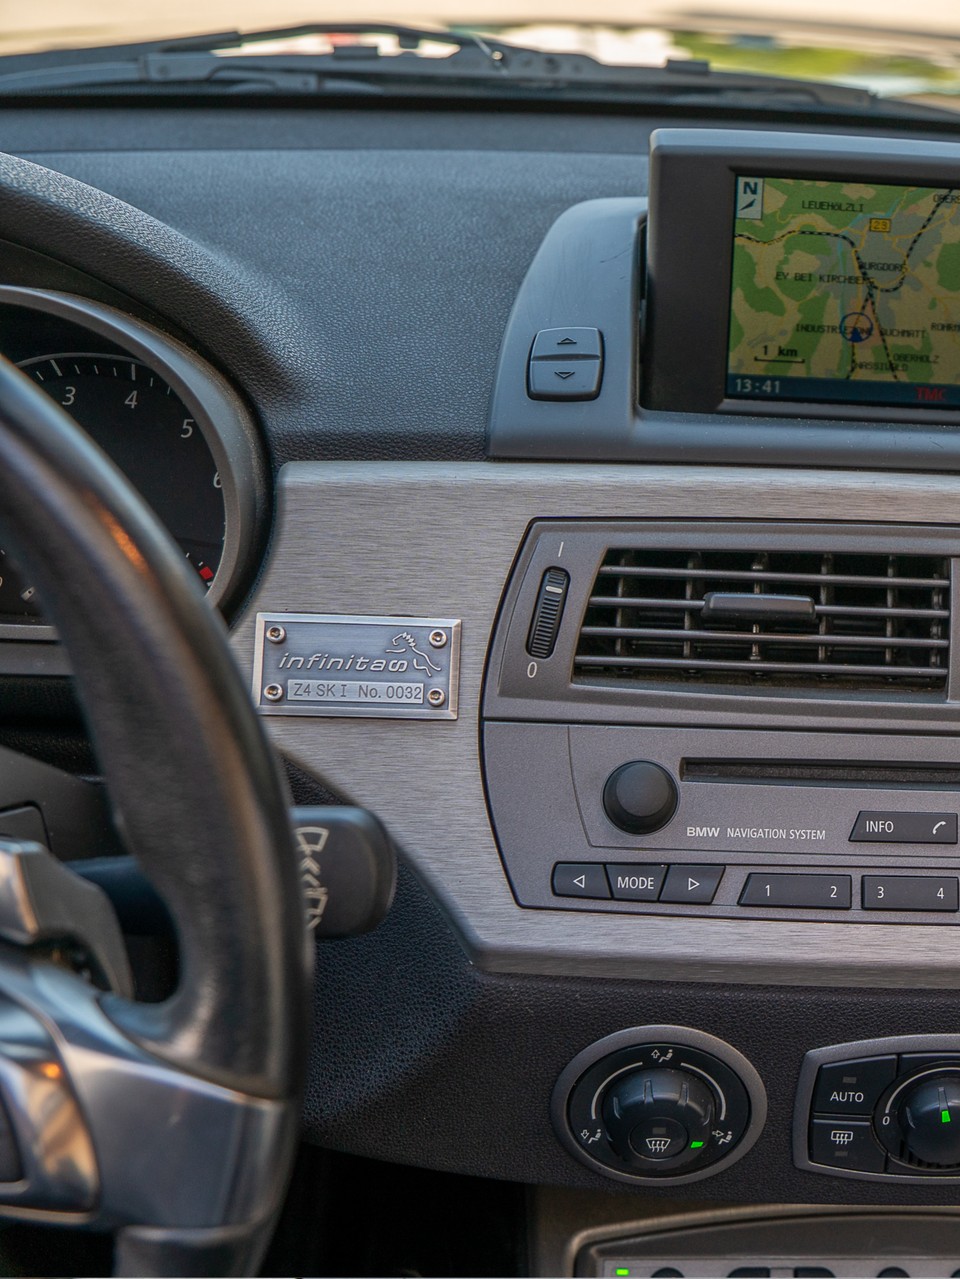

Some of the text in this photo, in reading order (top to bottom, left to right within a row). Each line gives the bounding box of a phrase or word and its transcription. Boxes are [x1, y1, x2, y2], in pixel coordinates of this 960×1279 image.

[743, 181, 757, 195] N
[873, 220, 888, 231] 23
[794, 272, 812, 283] BEI
[818, 274, 875, 287] KIRCHBE
[762, 345, 798, 358] 1 km
[735, 378, 781, 393] 13:41
[61, 386, 77, 406] 3
[124, 390, 139, 409] 4
[180, 418, 194, 439] 5
[212, 470, 223, 489] 6
[293, 683, 311, 697] Z4
[315, 683, 336, 698] SK
[357, 685, 382, 699] No.
[385, 686, 423, 701] 0032
[866, 820, 894, 833] INFO
[685, 826, 827, 842] BMW NAVIGATION SYSTEM
[617, 876, 655, 890] MODE
[765, 884, 837, 898] 1 2
[877, 886, 945, 899] 3 4
[829, 1091, 864, 1103] AUTO
